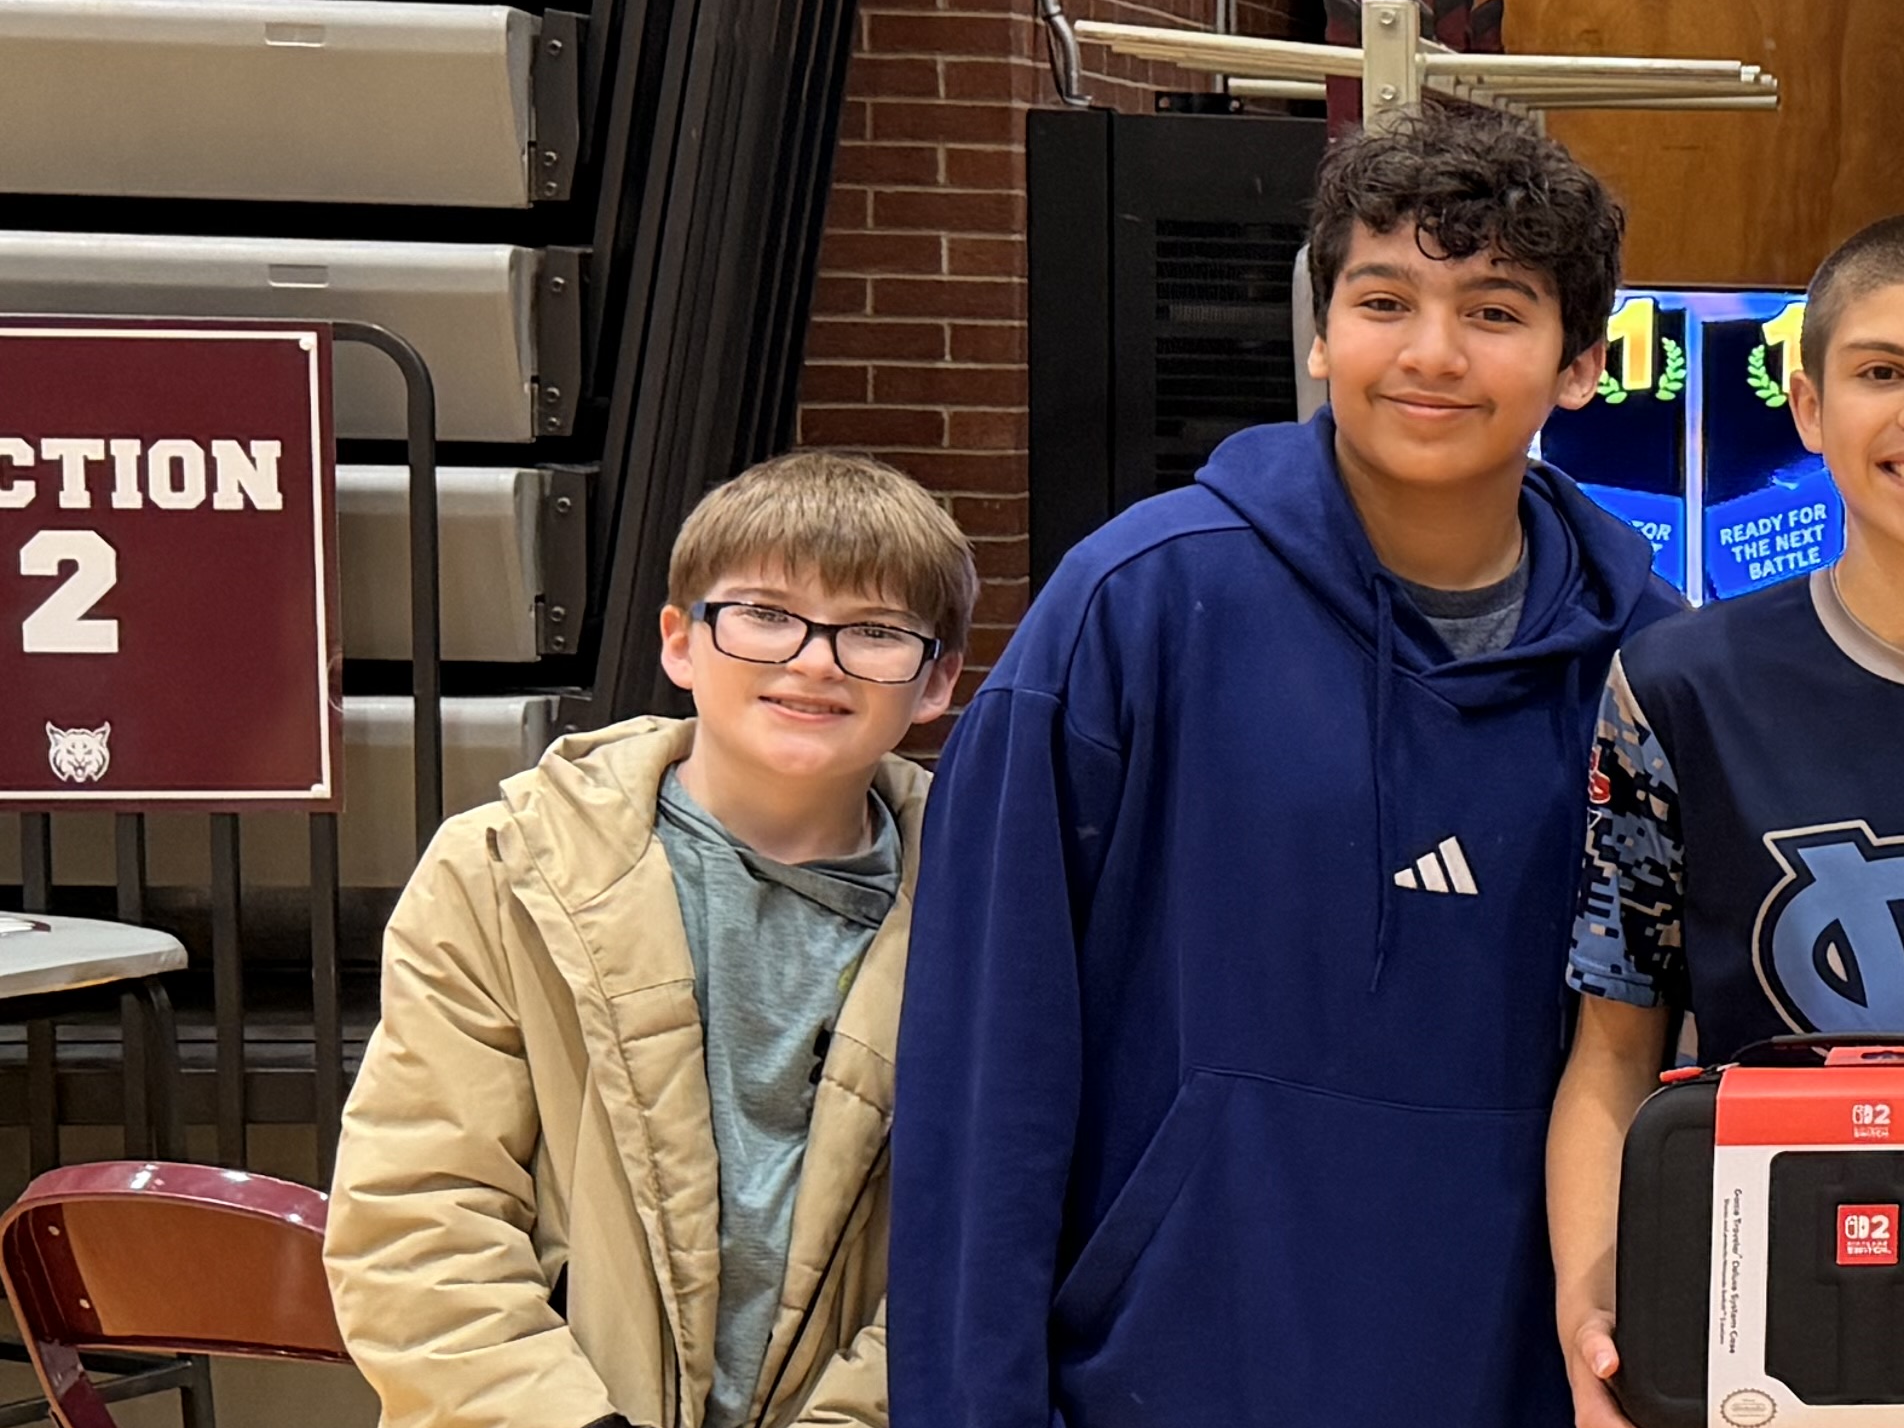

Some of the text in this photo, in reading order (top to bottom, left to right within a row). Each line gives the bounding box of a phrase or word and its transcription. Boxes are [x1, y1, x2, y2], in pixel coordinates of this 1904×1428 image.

[1607, 297, 1655, 390] 1
[1720, 503, 1827, 546] READY FOR
[1731, 523, 1825, 563] THE NEXT
[1749, 546, 1822, 581] BATTLE
[20, 530, 119, 653] 2
